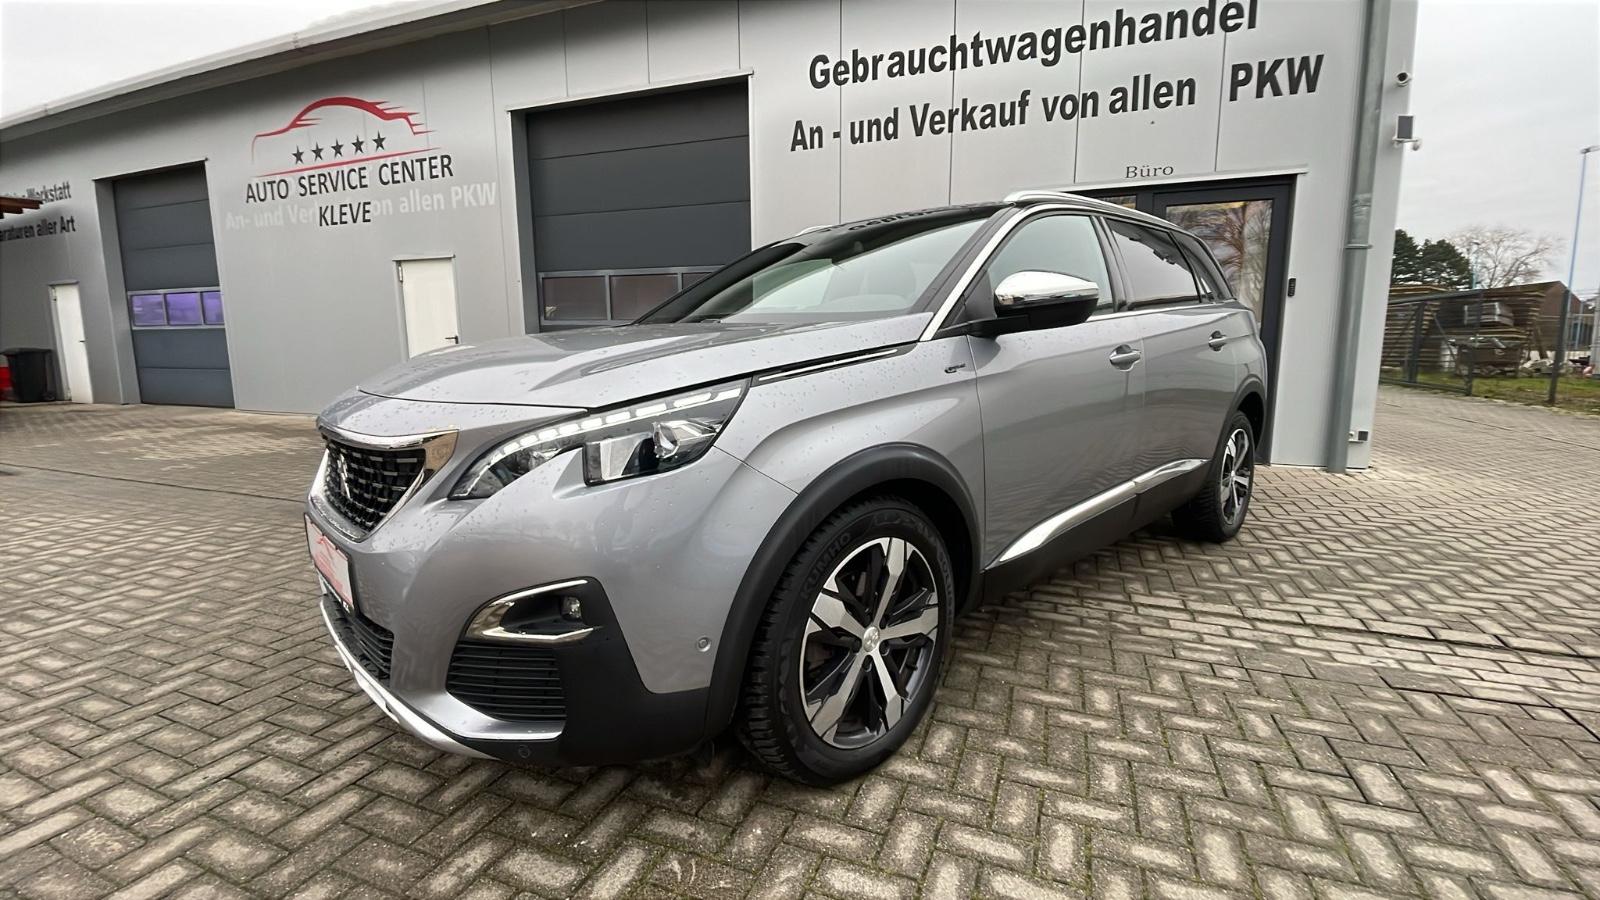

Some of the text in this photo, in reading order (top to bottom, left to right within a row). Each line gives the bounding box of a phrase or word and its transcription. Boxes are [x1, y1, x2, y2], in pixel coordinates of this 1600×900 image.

[809, 0, 1258, 90] Gebrauchtwagenhandel
[790, 120, 824, 152] An
[849, 107, 899, 145] und
[909, 89, 1031, 137] Verkauf
[1041, 88, 1099, 122] von
[1108, 73, 1197, 114] allen
[1229, 54, 1325, 102] PKW
[245, 154, 454, 204] AUTO SERVICE CENTER
[1125, 164, 1175, 180] Büro
[318, 201, 372, 227] KLEVE
[399, 188, 445, 214] allen
[450, 182, 497, 209] PKW
[60, 215, 76, 234] Art
